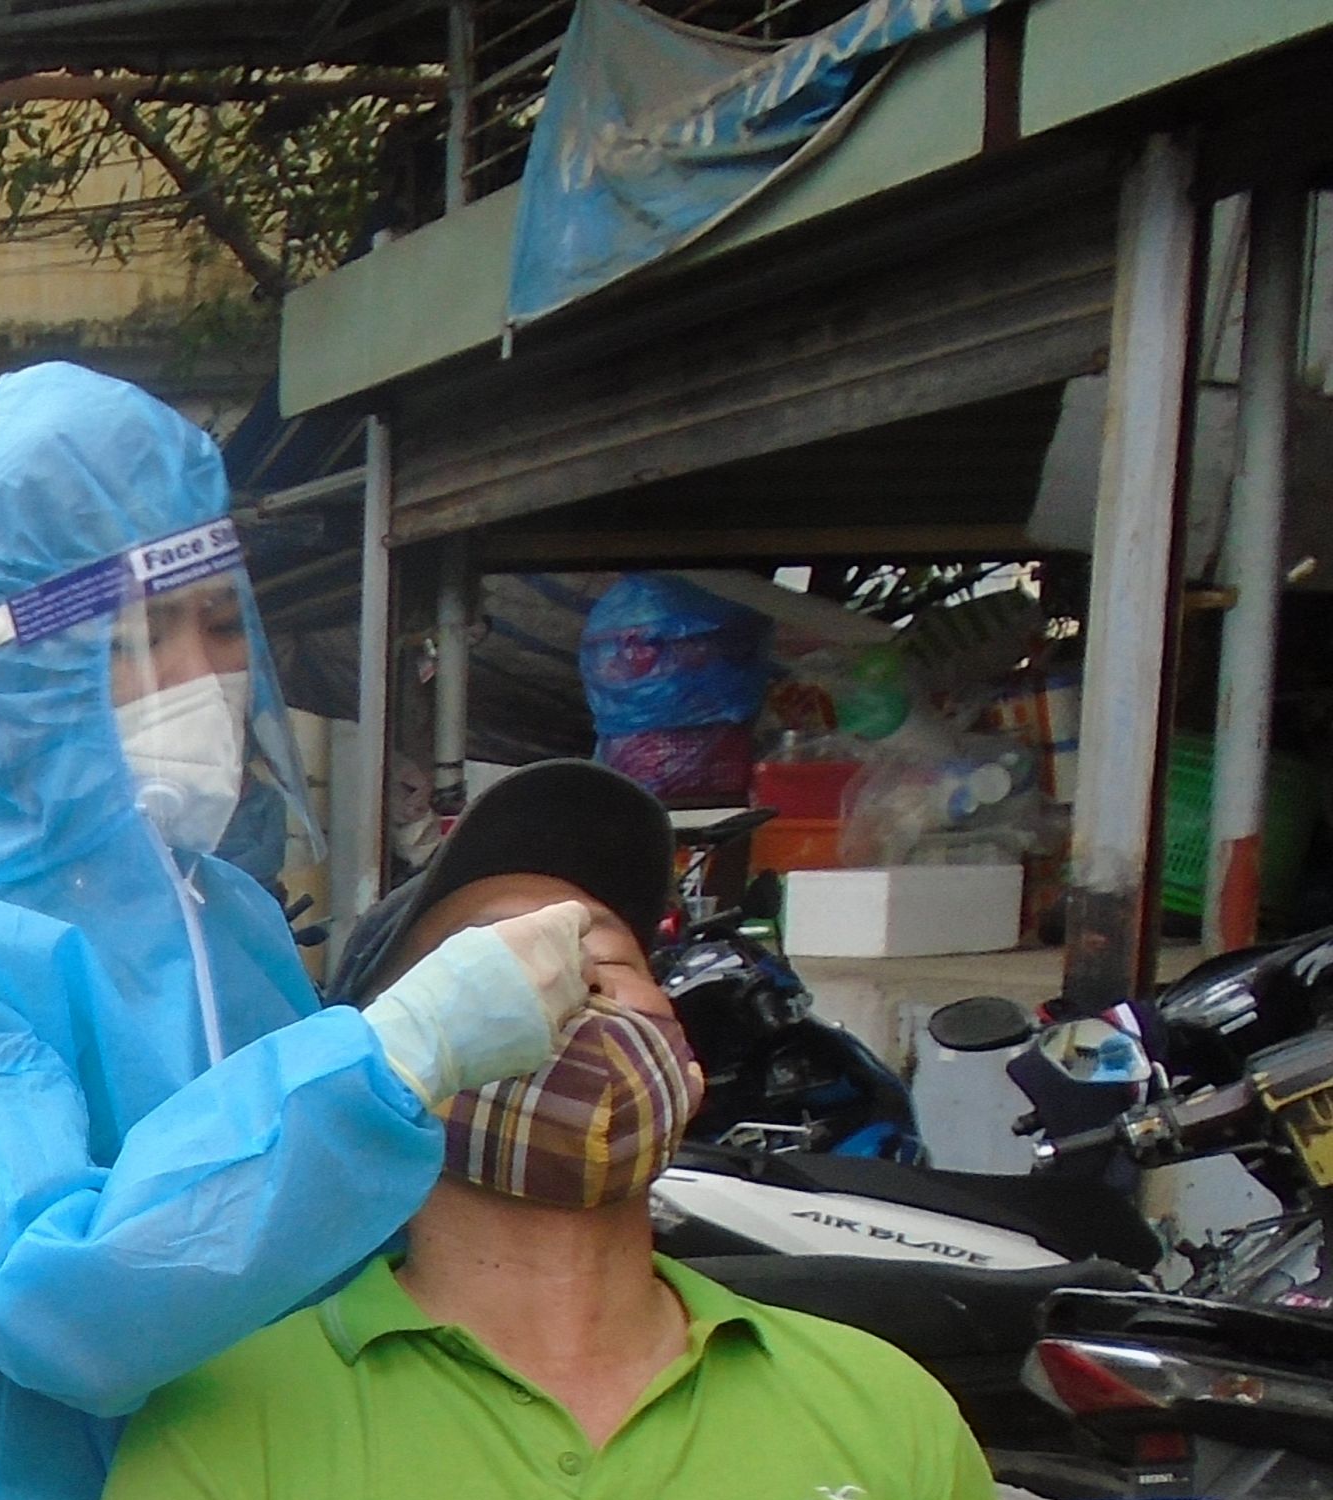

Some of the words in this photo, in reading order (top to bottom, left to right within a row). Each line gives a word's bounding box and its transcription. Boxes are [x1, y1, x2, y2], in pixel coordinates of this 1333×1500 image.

[143, 538, 205, 571] Face
[791, 1210, 864, 1234] AIR
[869, 1224, 996, 1266] BLADE
